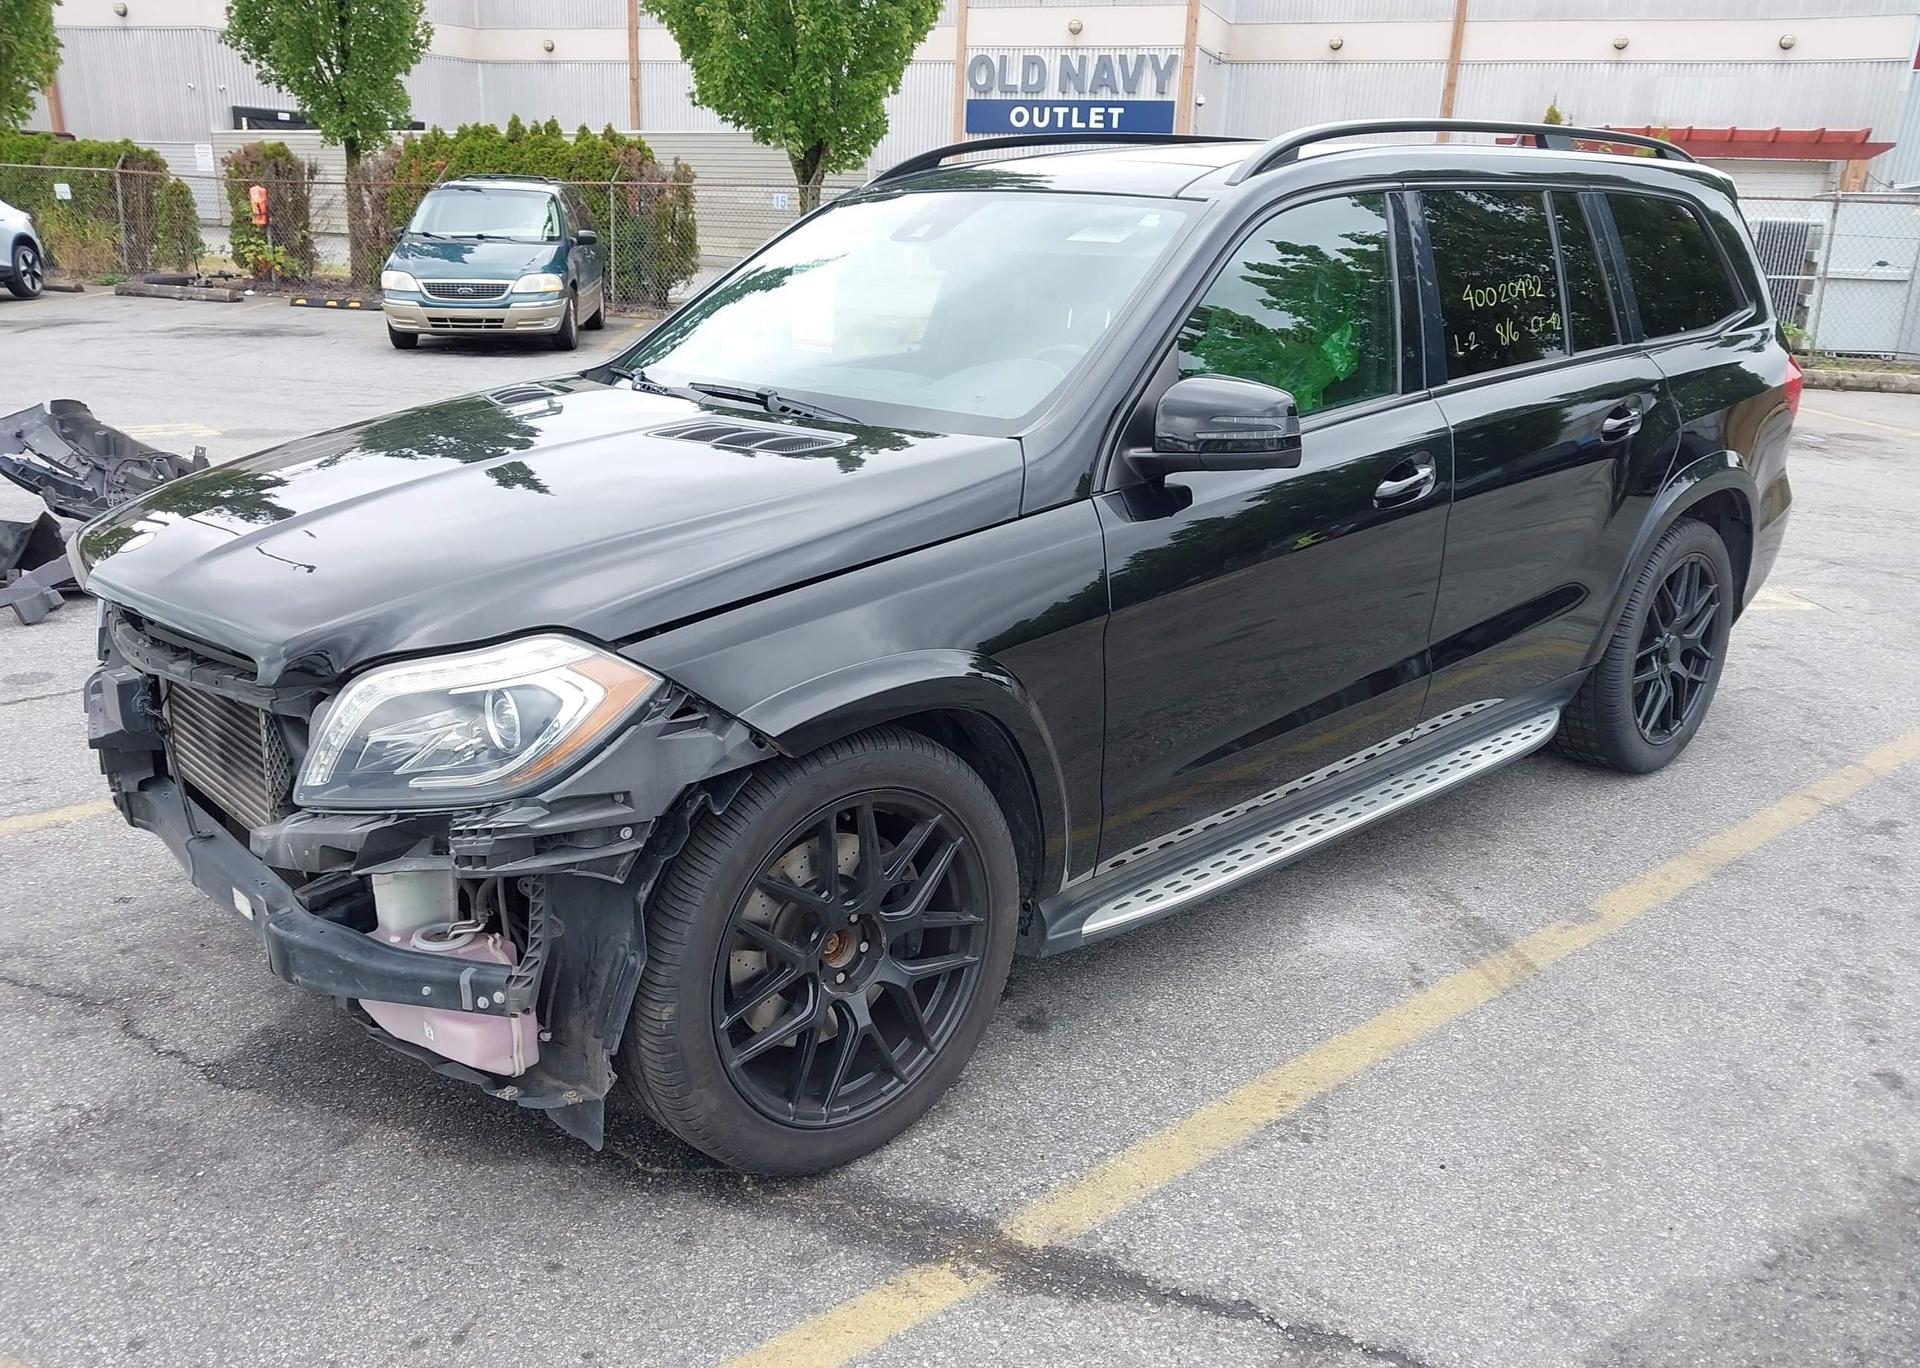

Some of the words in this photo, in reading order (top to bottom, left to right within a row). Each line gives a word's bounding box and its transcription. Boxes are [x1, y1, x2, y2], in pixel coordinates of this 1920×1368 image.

[968, 54, 1047, 93] OLD
[1058, 54, 1178, 94] NAVY
[1009, 106, 1125, 129] OUTLET
